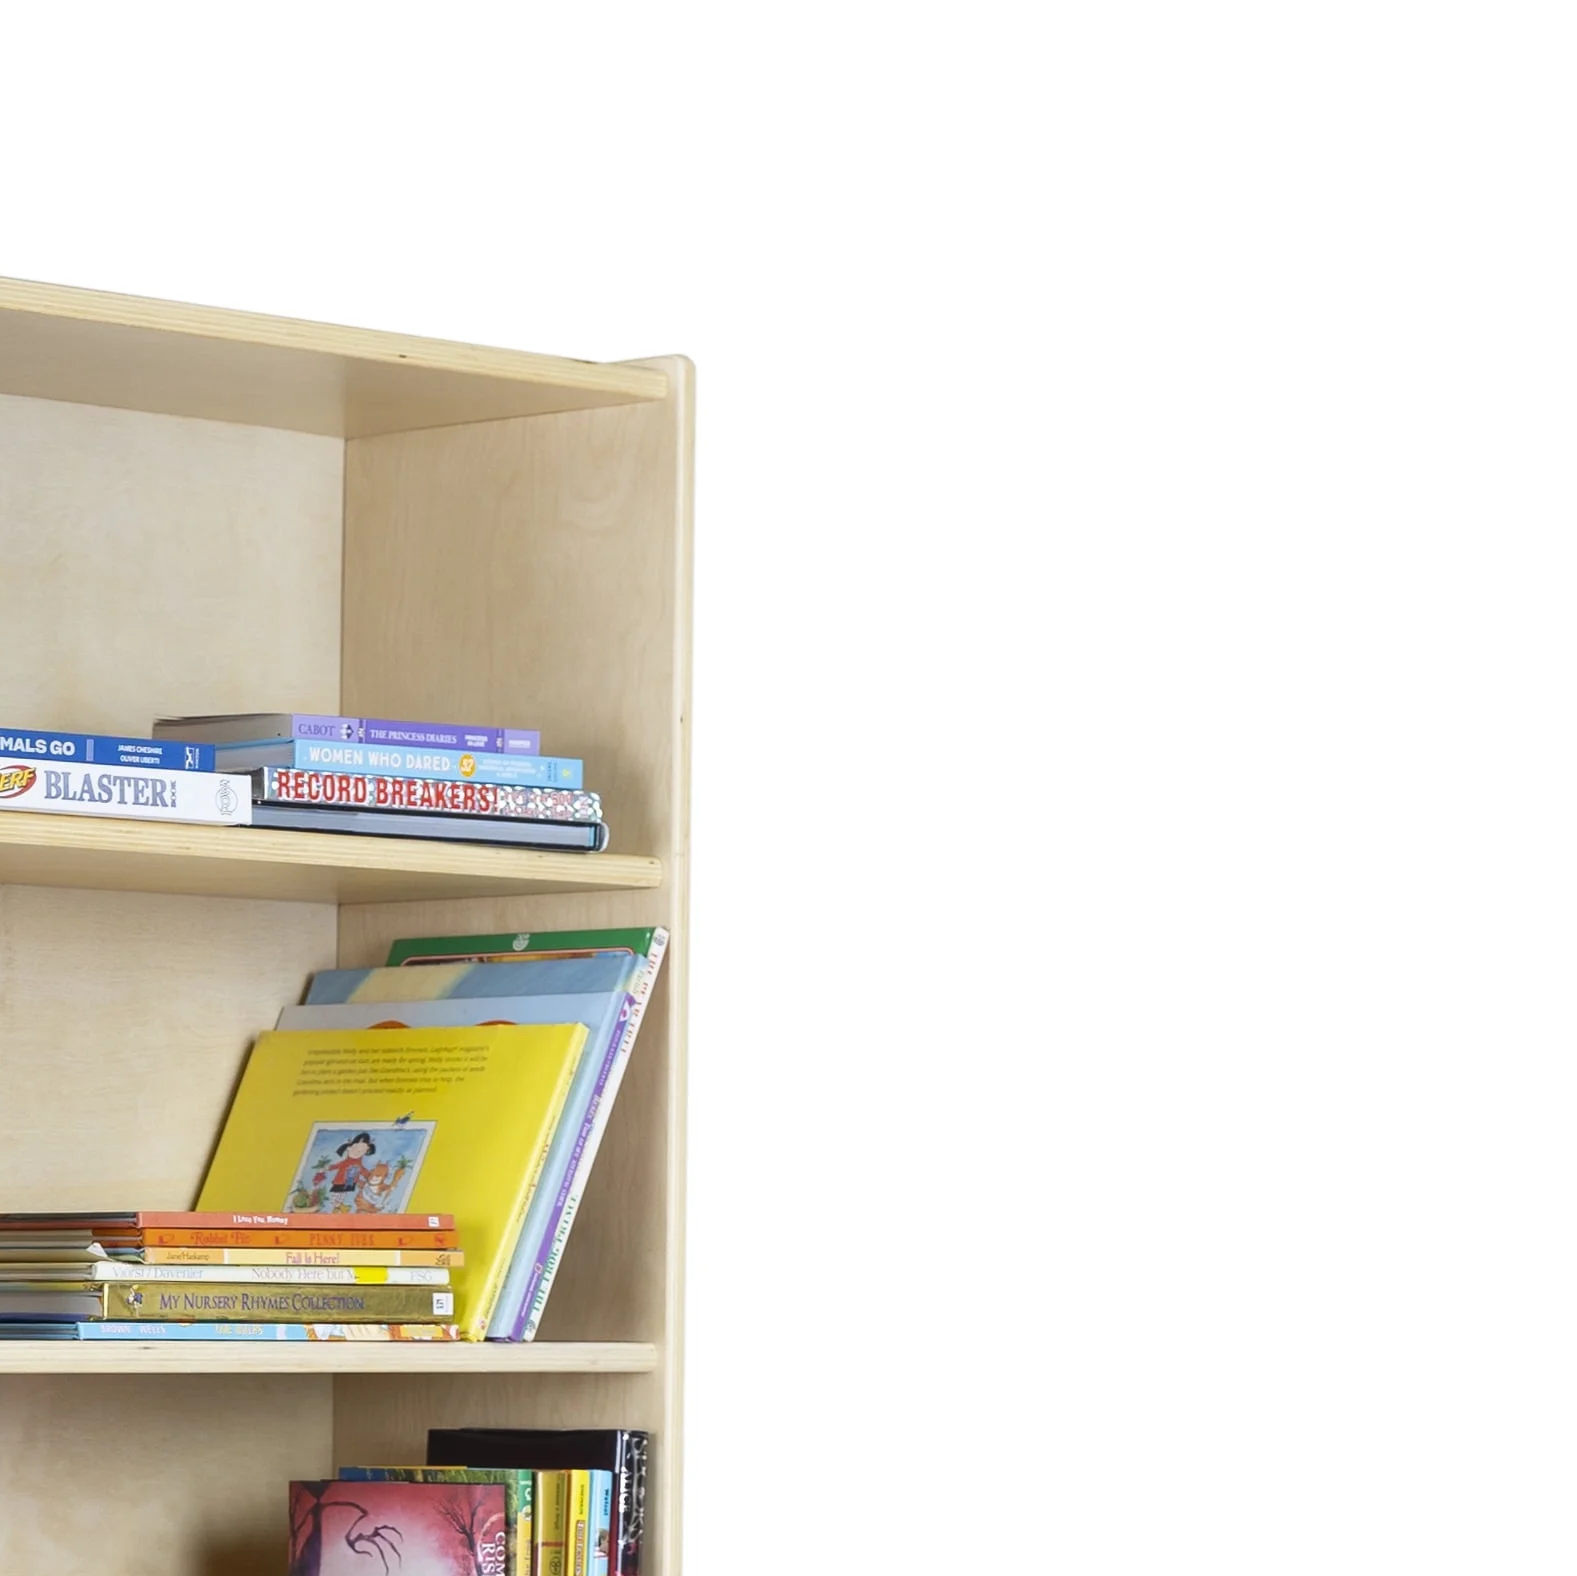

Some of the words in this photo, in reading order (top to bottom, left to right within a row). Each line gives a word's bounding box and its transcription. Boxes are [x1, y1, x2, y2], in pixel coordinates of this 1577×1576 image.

[298, 723, 335, 736] CABOT
[370, 729, 388, 738] THE
[388, 730, 425, 741] PRINCESS
[426, 733, 457, 745] DIARIES
[50, 741, 75, 756] GO
[309, 747, 364, 765] WOMEN
[368, 752, 401, 767] WHO
[406, 754, 450, 771] DARED
[43, 770, 169, 807] BLASTER
[277, 771, 367, 803] RECORD
[375, 777, 499, 812] BREAKERS!
[286, 1252, 302, 1263] Fall
[313, 1253, 341, 1264] Here!
[252, 1268, 293, 1281] Nobody
[297, 1269, 321, 1280] Here
[327, 1269, 344, 1280] but
[160, 1295, 181, 1310] MY
[184, 1293, 238, 1310] NURSERY
[241, 1293, 290, 1310] RHYMES
[292, 1293, 365, 1312] COLLECTION
